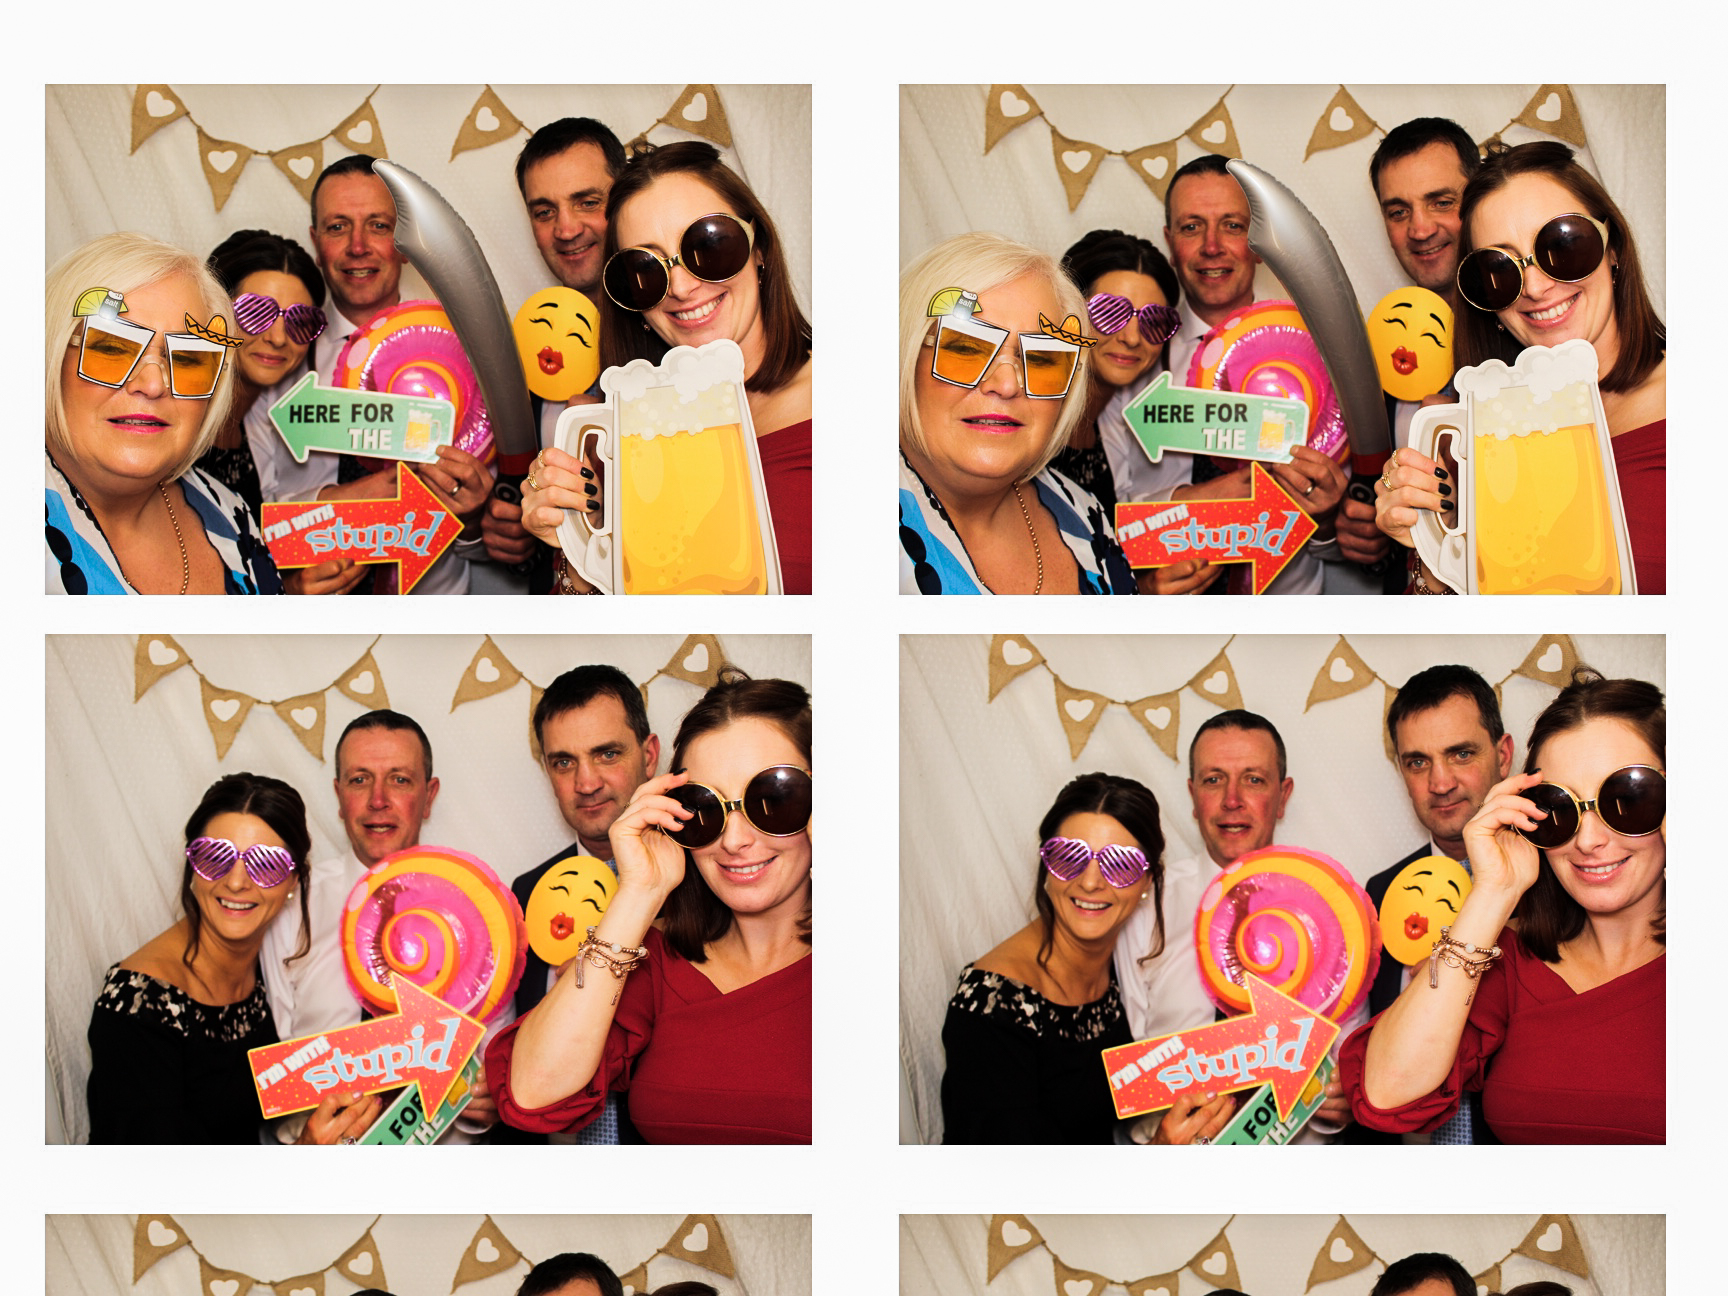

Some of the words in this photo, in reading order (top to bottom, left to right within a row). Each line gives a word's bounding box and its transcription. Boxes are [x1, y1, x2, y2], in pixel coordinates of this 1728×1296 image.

[104, 298, 119, 308] salt
[958, 298, 973, 308] salt
[289, 404, 340, 424] HERE
[350, 403, 394, 423] FOR
[1143, 404, 1194, 424] HERE
[1204, 403, 1248, 423] FOR
[347, 427, 392, 450] THE
[1201, 427, 1246, 450] THE
[304, 511, 447, 556] stupid
[1158, 511, 1301, 556] stupid
[302, 1017, 462, 1094] stupid
[1156, 1017, 1316, 1094] stupid
